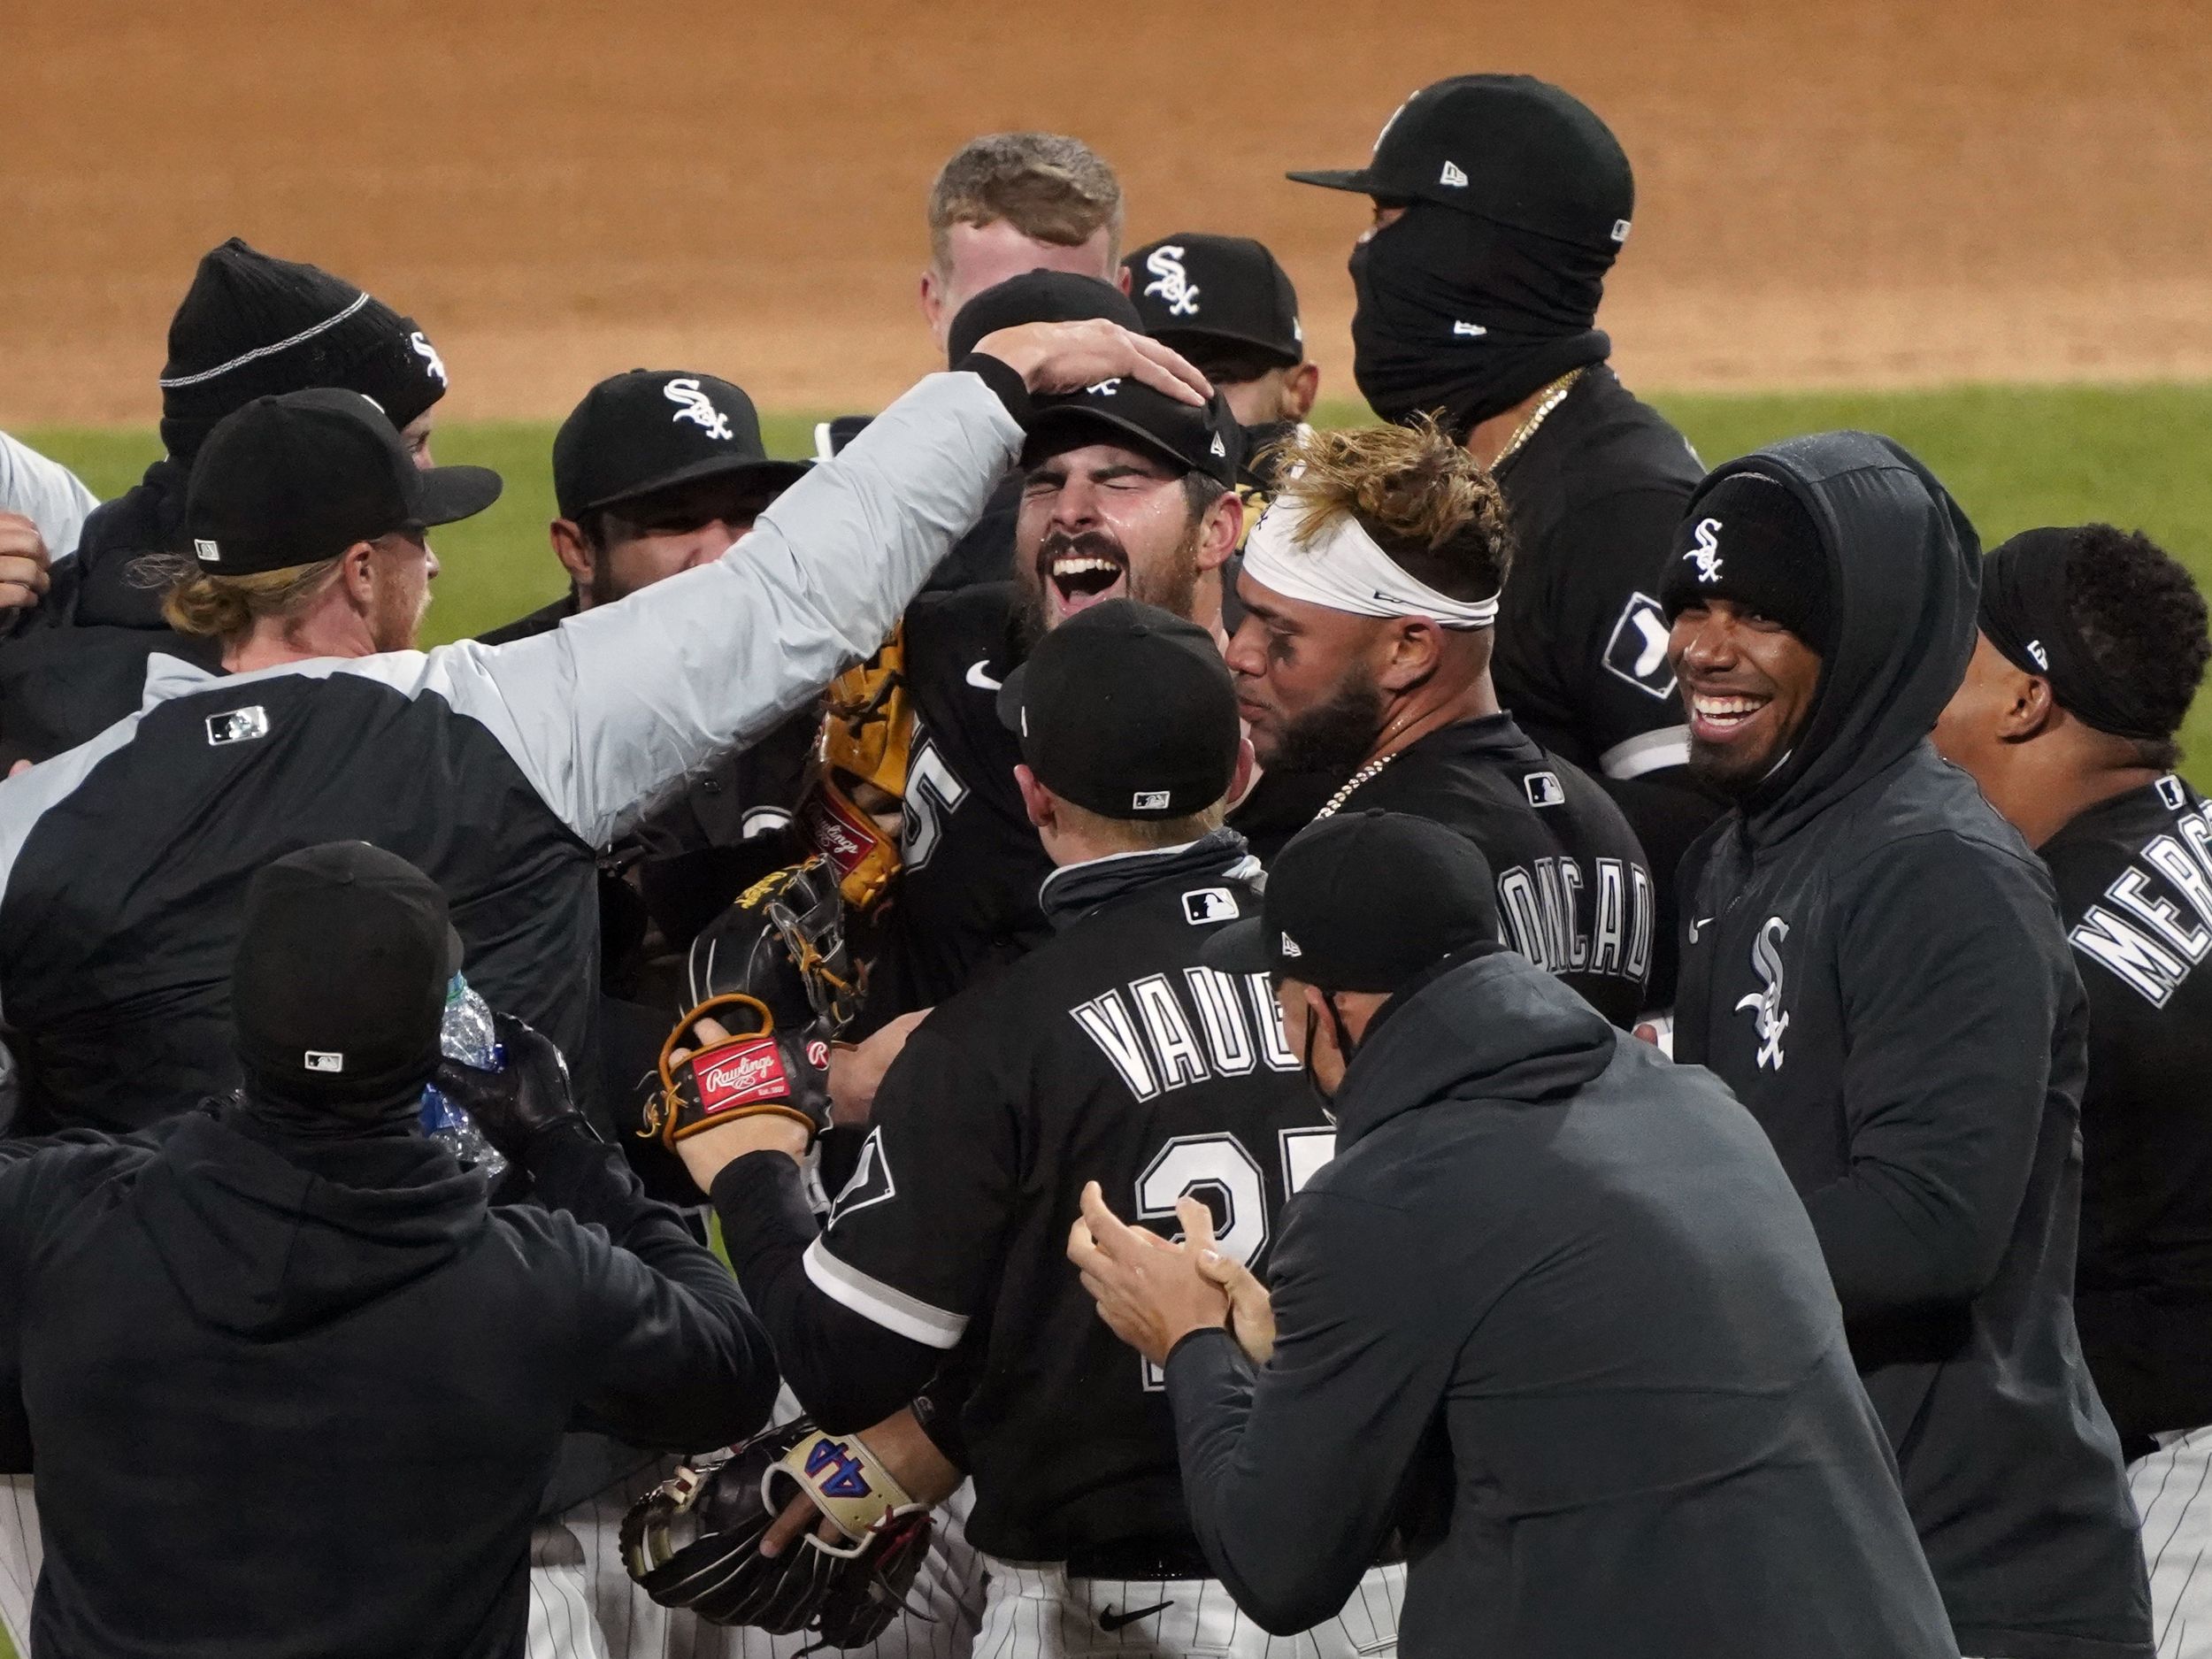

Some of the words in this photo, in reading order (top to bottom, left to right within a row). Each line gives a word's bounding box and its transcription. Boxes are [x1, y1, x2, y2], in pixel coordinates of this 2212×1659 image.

[1144, 245, 1200, 315] Sox
[663, 378, 734, 440] Sox
[1683, 518, 1724, 582] Sox
[1734, 916, 1790, 1071] Sox
[706, 1055, 774, 1093] Rawlings
